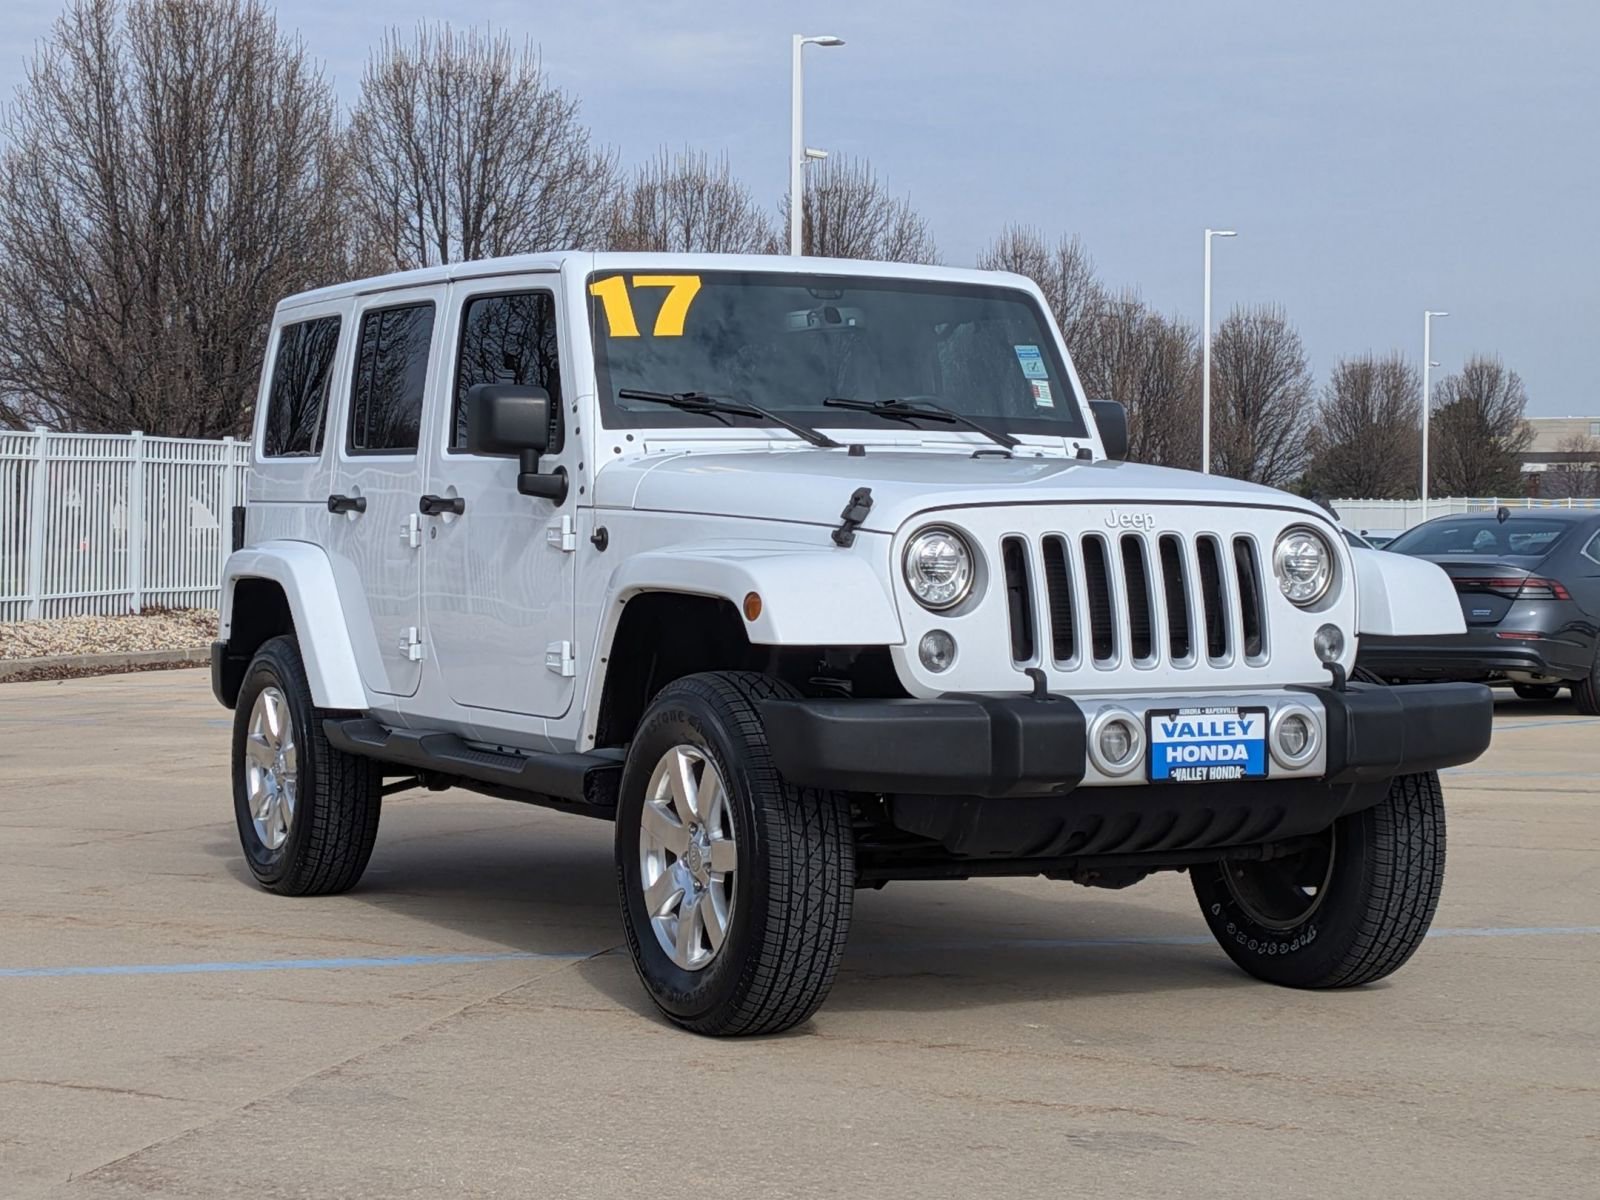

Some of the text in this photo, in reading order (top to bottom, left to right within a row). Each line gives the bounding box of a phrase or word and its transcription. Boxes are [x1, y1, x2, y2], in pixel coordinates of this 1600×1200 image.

[589, 275, 702, 337] 17
[1104, 508, 1155, 532] Jeep
[1160, 720, 1255, 738] VALLEY
[1166, 743, 1249, 763] HONDA
[1176, 765, 1241, 782] VALLEY HONDA
